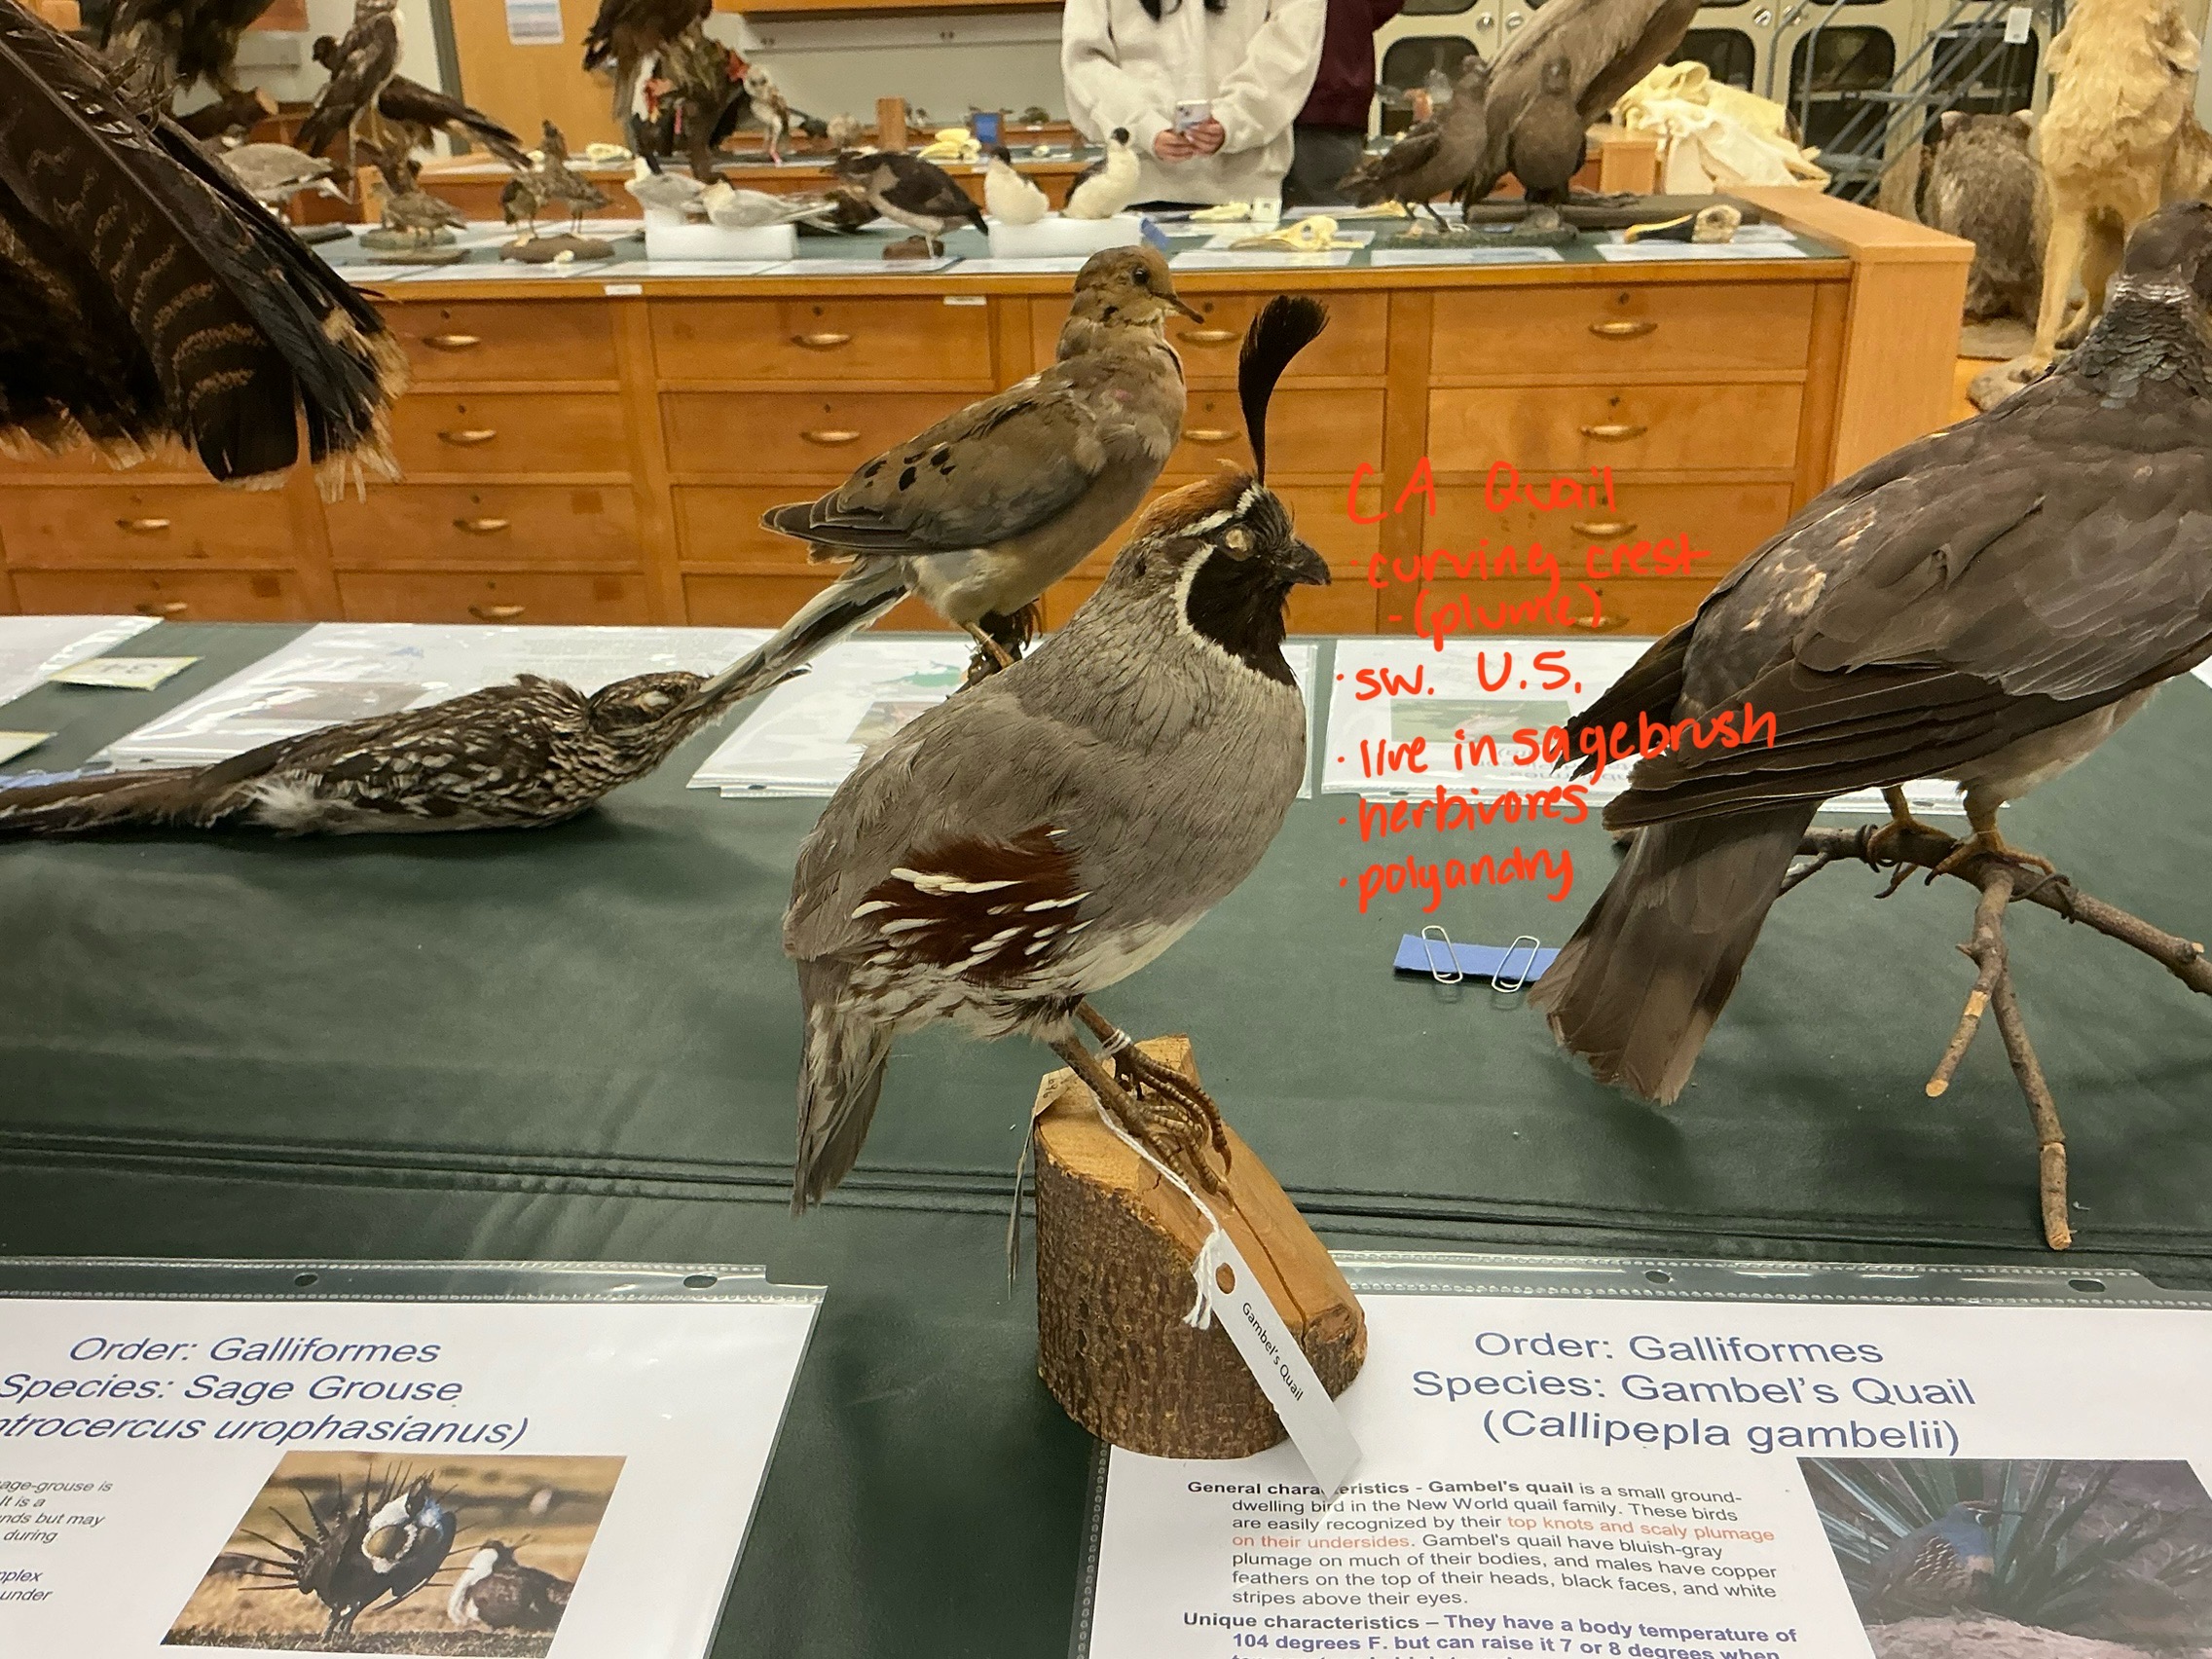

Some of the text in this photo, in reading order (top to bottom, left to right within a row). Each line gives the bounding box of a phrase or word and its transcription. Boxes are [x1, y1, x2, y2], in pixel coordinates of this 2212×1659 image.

[68, 1335, 441, 1364] Order: Galliformes
[1242, 1303, 1304, 1401] Gambel's Quail
[1473, 1330, 1885, 1369] Order: Galliformes
[0, 1371, 463, 1408] Species: Sage Grouse
[1412, 1368, 1977, 1409] Species: Gambel's Quail
[214, 1414, 529, 1450] urophasianus)
[1482, 1409, 1961, 1456] (Callipepla gambelii)
[0, 1480, 113, 1493] age-grouse is
[1188, 1481, 1261, 1494] General
[1267, 1481, 1410, 1496] charaeristics
[1428, 1480, 1520, 1493] Gambel's
[1526, 1481, 1573, 1494] quail
[1580, 1482, 1595, 1495] is
[1601, 1485, 1611, 1496] a
[1617, 1485, 1666, 1500] small
[1671, 1489, 1743, 1504] ground-
[15, 1495, 30, 1507] is
[33, 1498, 46, 1508] a
[1232, 1496, 1739, 1523] dwelling bird in the New World quail family. These birds
[0, 1512, 105, 1528] nds but may
[1232, 1515, 1775, 1544] are easily recognized by their top knots and scaly plumage
[4, 1529, 58, 1544] during
[1232, 1533, 1722, 1561] on their undersides. Gambel's quail have bluish-gray
[1232, 1551, 1777, 1580] plumage on much of their bodies, and males have copper
[0, 1588, 53, 1601] under
[1232, 1570, 1777, 1599] feathers on the top of their heads, black faces, and white
[1232, 1590, 1468, 1607] stripes above their eyes.
[1183, 1611, 1257, 1630] Unique
[1264, 1615, 1419, 1630] characteristics
[1444, 1613, 1496, 1632] They
[1502, 1615, 1554, 1632] have
[1561, 1621, 1573, 1632] a
[1579, 1618, 1633, 1639] body
[1639, 1622, 1769, 1641] temperature
[1775, 1628, 1797, 1642] of
[1233, 1633, 1780, 1659] 104 degrees F. but can raise it 7 or 8 degrees when
